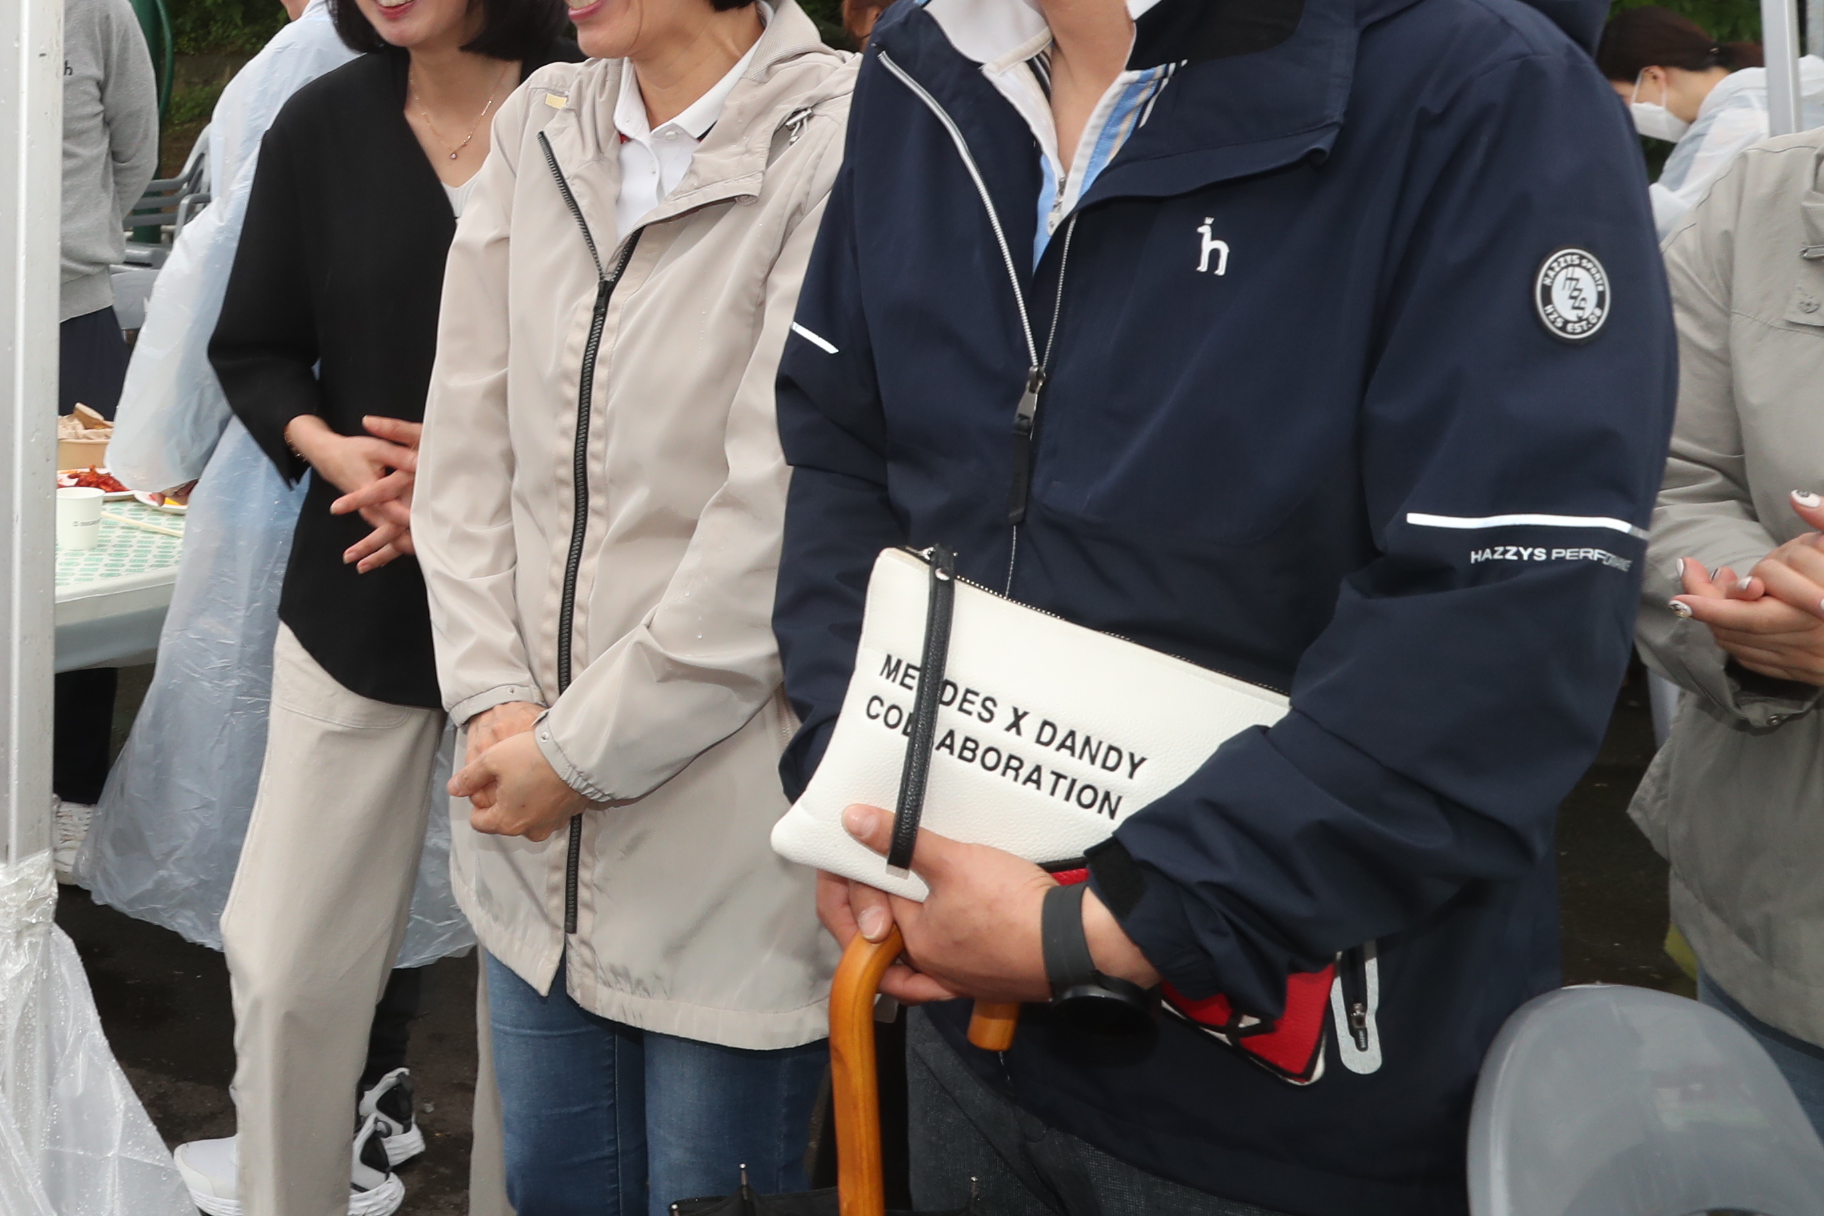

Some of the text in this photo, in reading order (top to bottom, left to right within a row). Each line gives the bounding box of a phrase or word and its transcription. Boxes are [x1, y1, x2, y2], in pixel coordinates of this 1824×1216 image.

[1470, 545, 1548, 565] HAZZYS
[865, 694, 1124, 821] COLABORATION
[879, 652, 1149, 781] MEDES X DANDY
